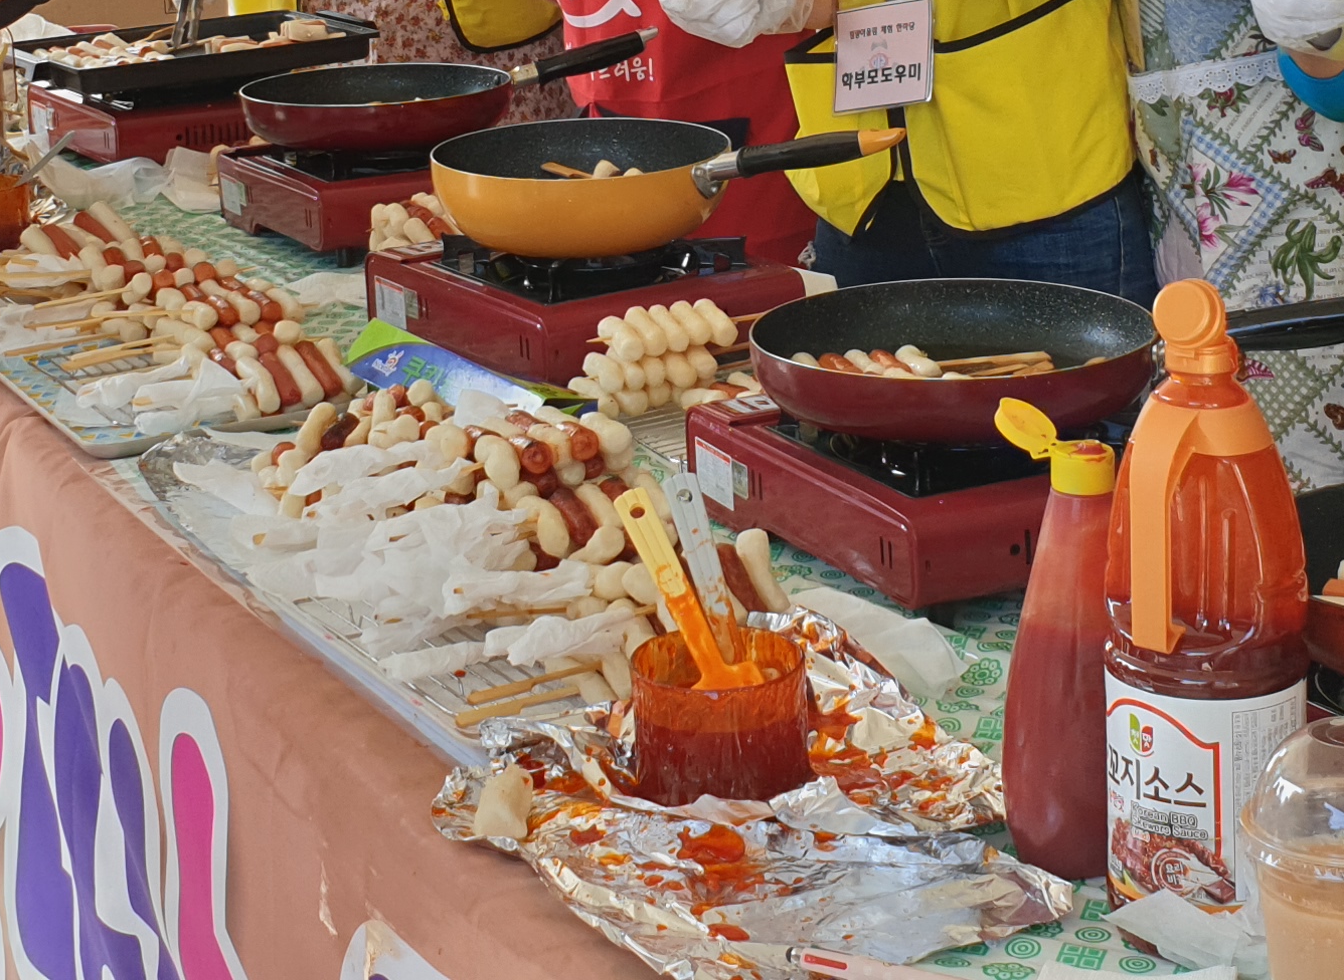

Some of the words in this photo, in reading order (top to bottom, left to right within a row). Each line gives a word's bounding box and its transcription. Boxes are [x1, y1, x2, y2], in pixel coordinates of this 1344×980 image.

[841, 63, 921, 91] 학부모도우미
[1108, 742, 1207, 808] 꼬지소스
[1131, 800, 1168, 824] Korean
[1170, 812, 1198, 828] BBQ
[1172, 824, 1209, 841] Sauce
